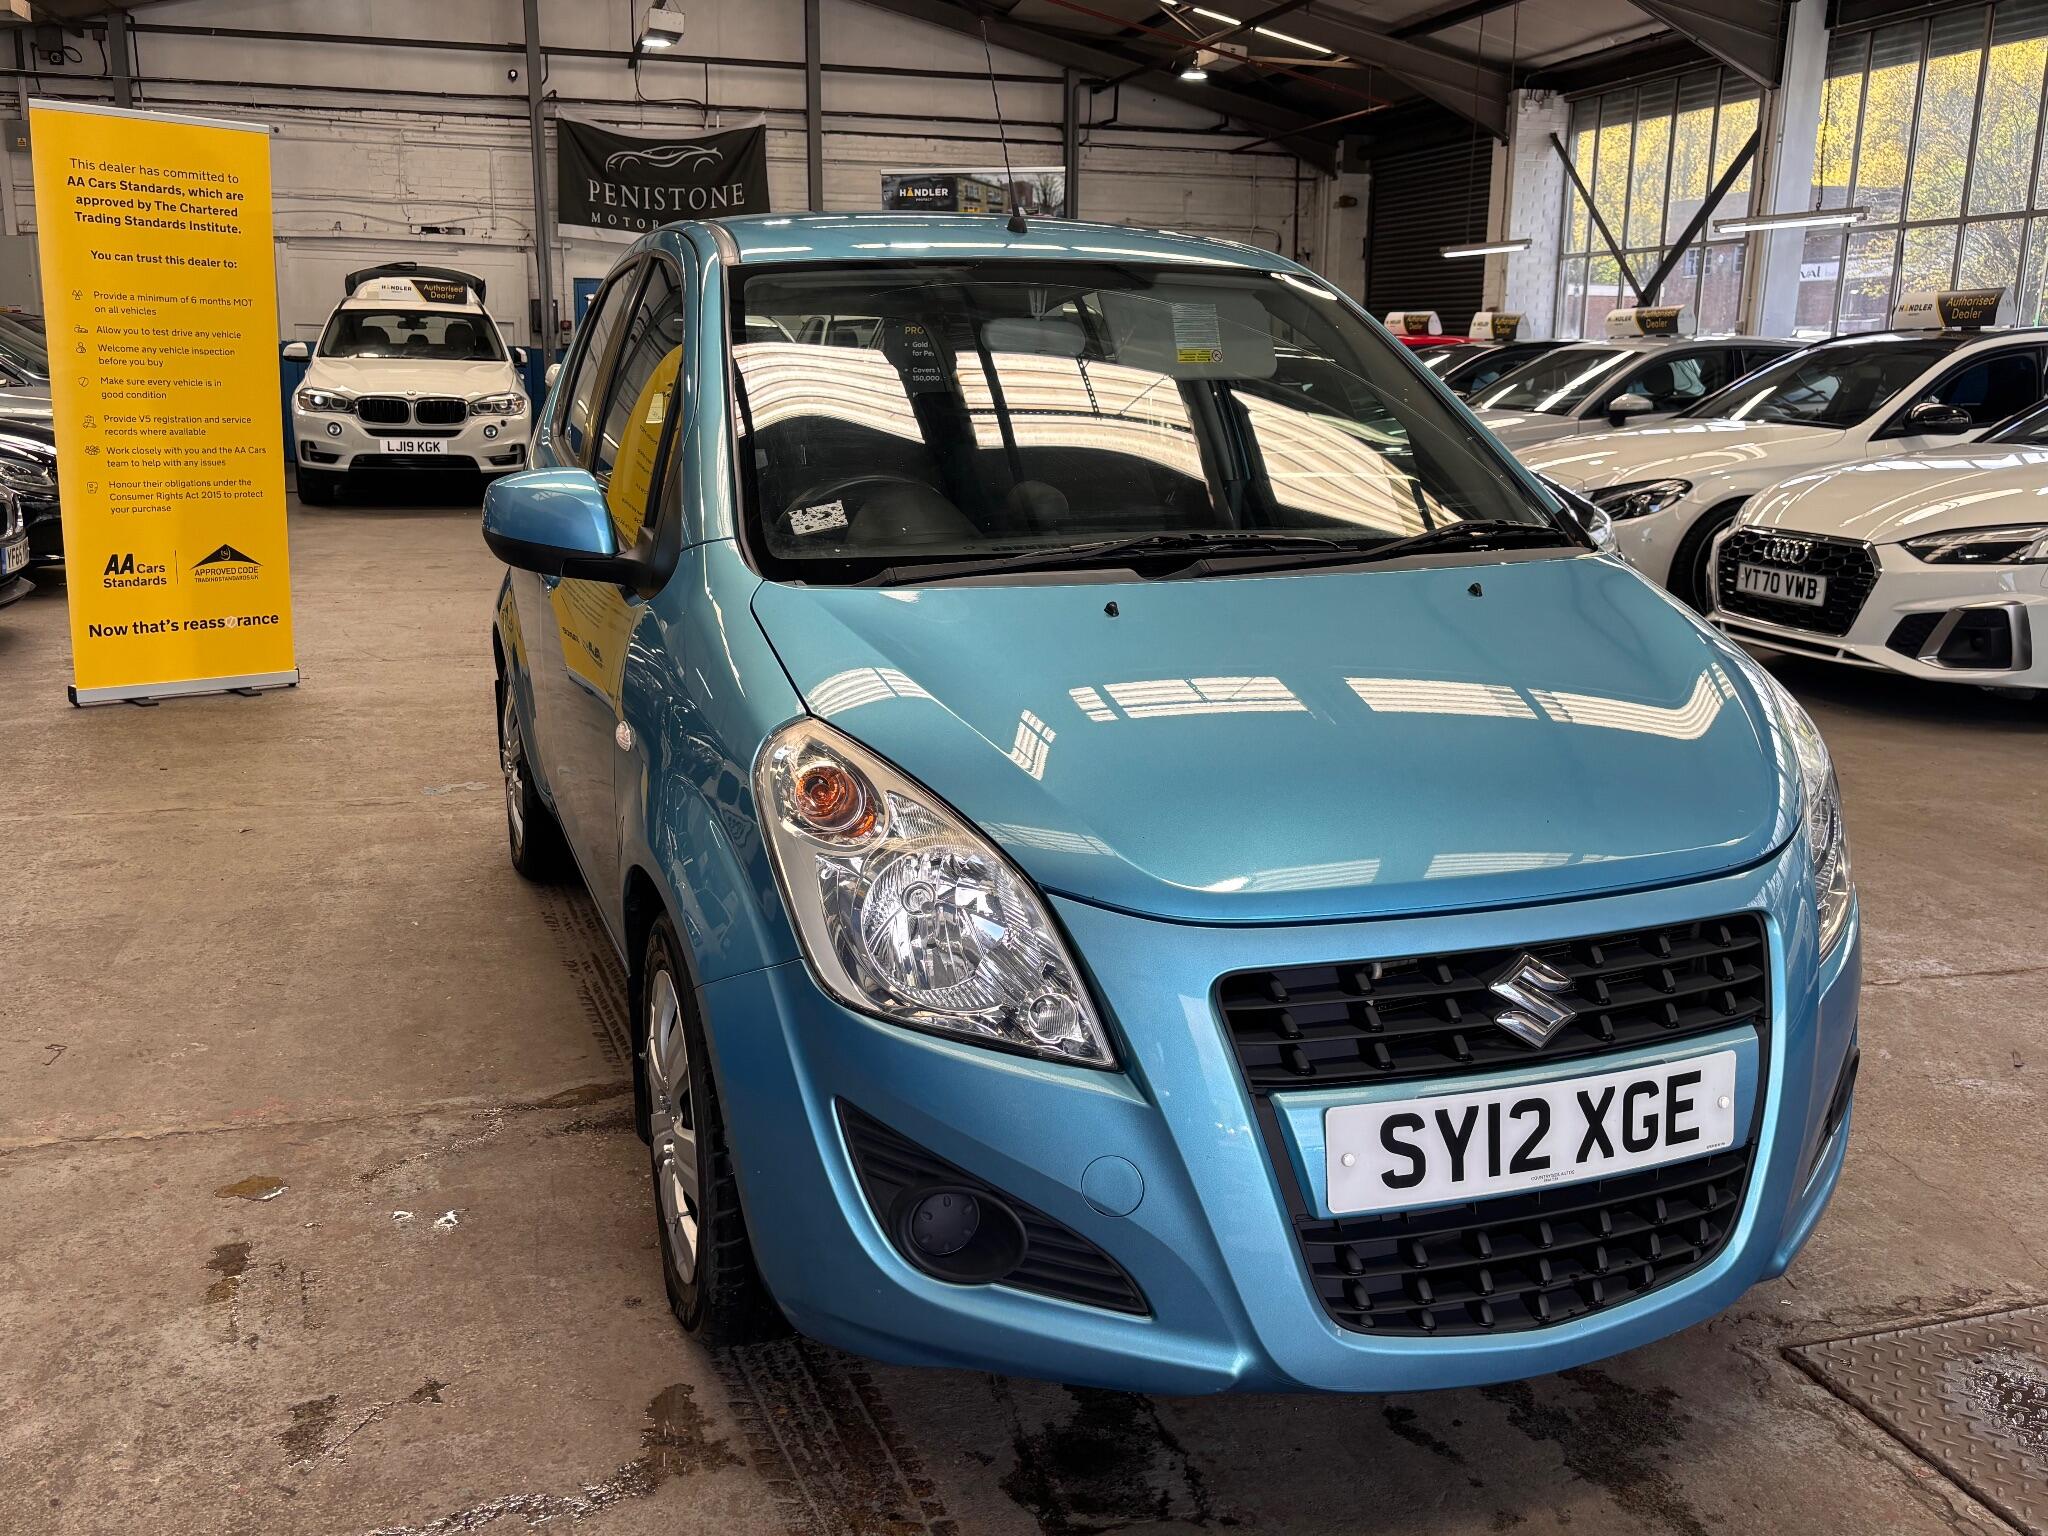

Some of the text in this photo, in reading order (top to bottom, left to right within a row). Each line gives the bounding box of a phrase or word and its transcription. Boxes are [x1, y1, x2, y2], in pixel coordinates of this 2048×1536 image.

[69, 157, 239, 184] This dealer has committed to
[67, 176, 244, 201] AA Cars Standards, which are
[587, 178, 745, 211] PENISTONE
[76, 196, 238, 217] approved by The Chartered
[74, 211, 242, 234] Trading Standards Institute.
[591, 211, 660, 230] MOTOR
[91, 250, 237, 269] You can trust this dealer to:
[423, 283, 464, 293] Authorised
[93, 291, 127, 301] Provide
[137, 293, 178, 303] minimum
[180, 296, 189, 304] of
[190, 296, 197, 304] 6
[199, 297, 232, 306] months
[233, 298, 253, 308] MOT
[430, 291, 456, 300] Dealer
[1946, 294, 1998, 307] Authorised
[94, 305, 157, 316] on all vehicles
[1951, 308, 1983, 320] Dealer
[1645, 318, 1668, 329] Dealer
[96, 326, 121, 334] Allow
[123, 328, 139, 336] you
[152, 328, 169, 336] test
[171, 329, 193, 337] drive
[195, 331, 210, 339] any
[212, 331, 241, 339] vehicle
[97, 344, 236, 356] Welcome any vehicle inspection
[98, 357, 164, 368] before you buy
[100, 377, 124, 385] Make
[147, 379, 171, 387] every
[173, 379, 203, 387] vehicle
[205, 379, 213, 387] is
[214, 379, 222, 387] in
[101, 391, 167, 400] good condition
[103, 415, 137, 423] Provide
[153, 415, 202, 424] registration
[204, 415, 220, 424] and
[221, 416, 252, 424] service
[104, 428, 206, 436] records where available
[106, 446, 267, 456] Work closely with you and the AA Cars
[387, 441, 441, 452] LJ19 KGK
[107, 458, 226, 468] team to help with any issues
[108, 478, 252, 488] Honour their obligations under the
[109, 490, 264, 501] Consumer Rights Act 2015 to protect
[110, 504, 172, 515] your purchase
[103, 553, 166, 575] AA Cars
[194, 565, 259, 577] APPROVED CODE
[103, 575, 167, 589] Standards
[1743, 566, 1818, 600] YT70 VWB
[88, 623, 129, 638] Now
[132, 618, 179, 635] that's
[1379, 1069, 1702, 1190] SY12 XGE
